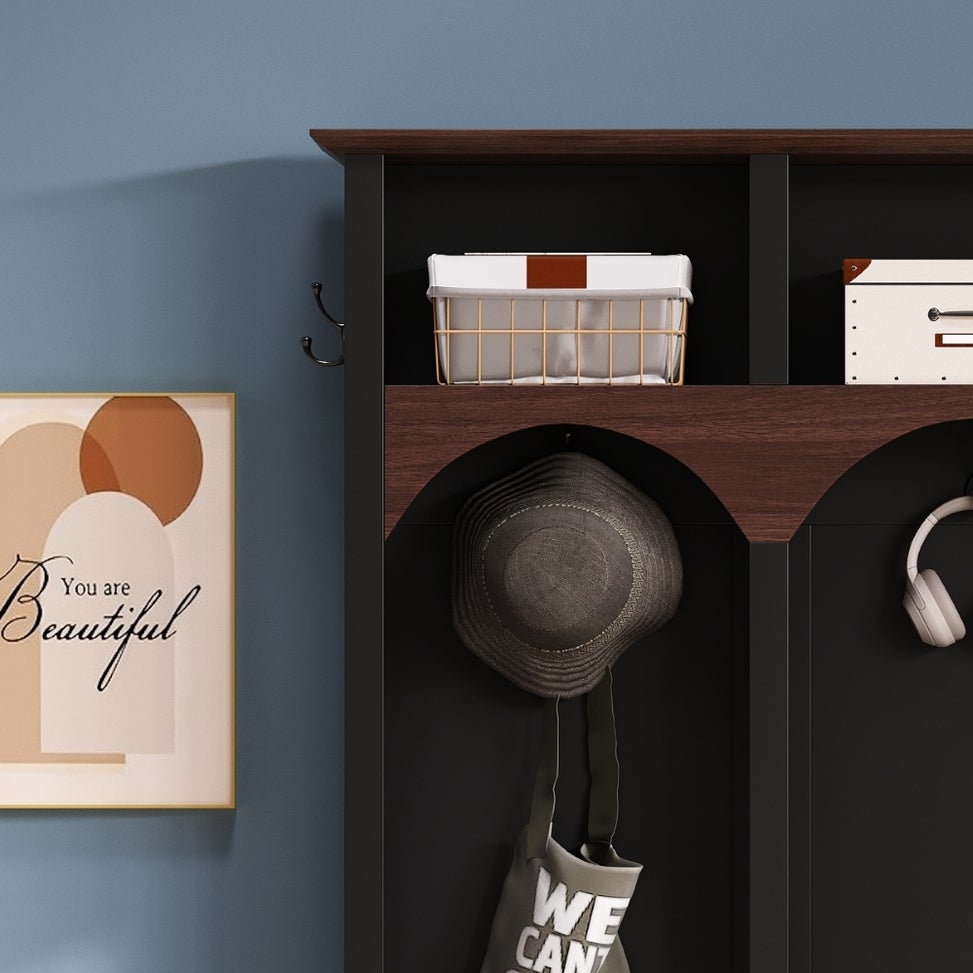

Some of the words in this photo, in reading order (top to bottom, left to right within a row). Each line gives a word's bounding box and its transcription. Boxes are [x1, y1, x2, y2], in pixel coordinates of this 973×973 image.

[0, 554, 202, 692] Beautiful
[60, 577, 97, 596] You
[103, 582, 131, 596] are
[532, 865, 631, 945] WE
